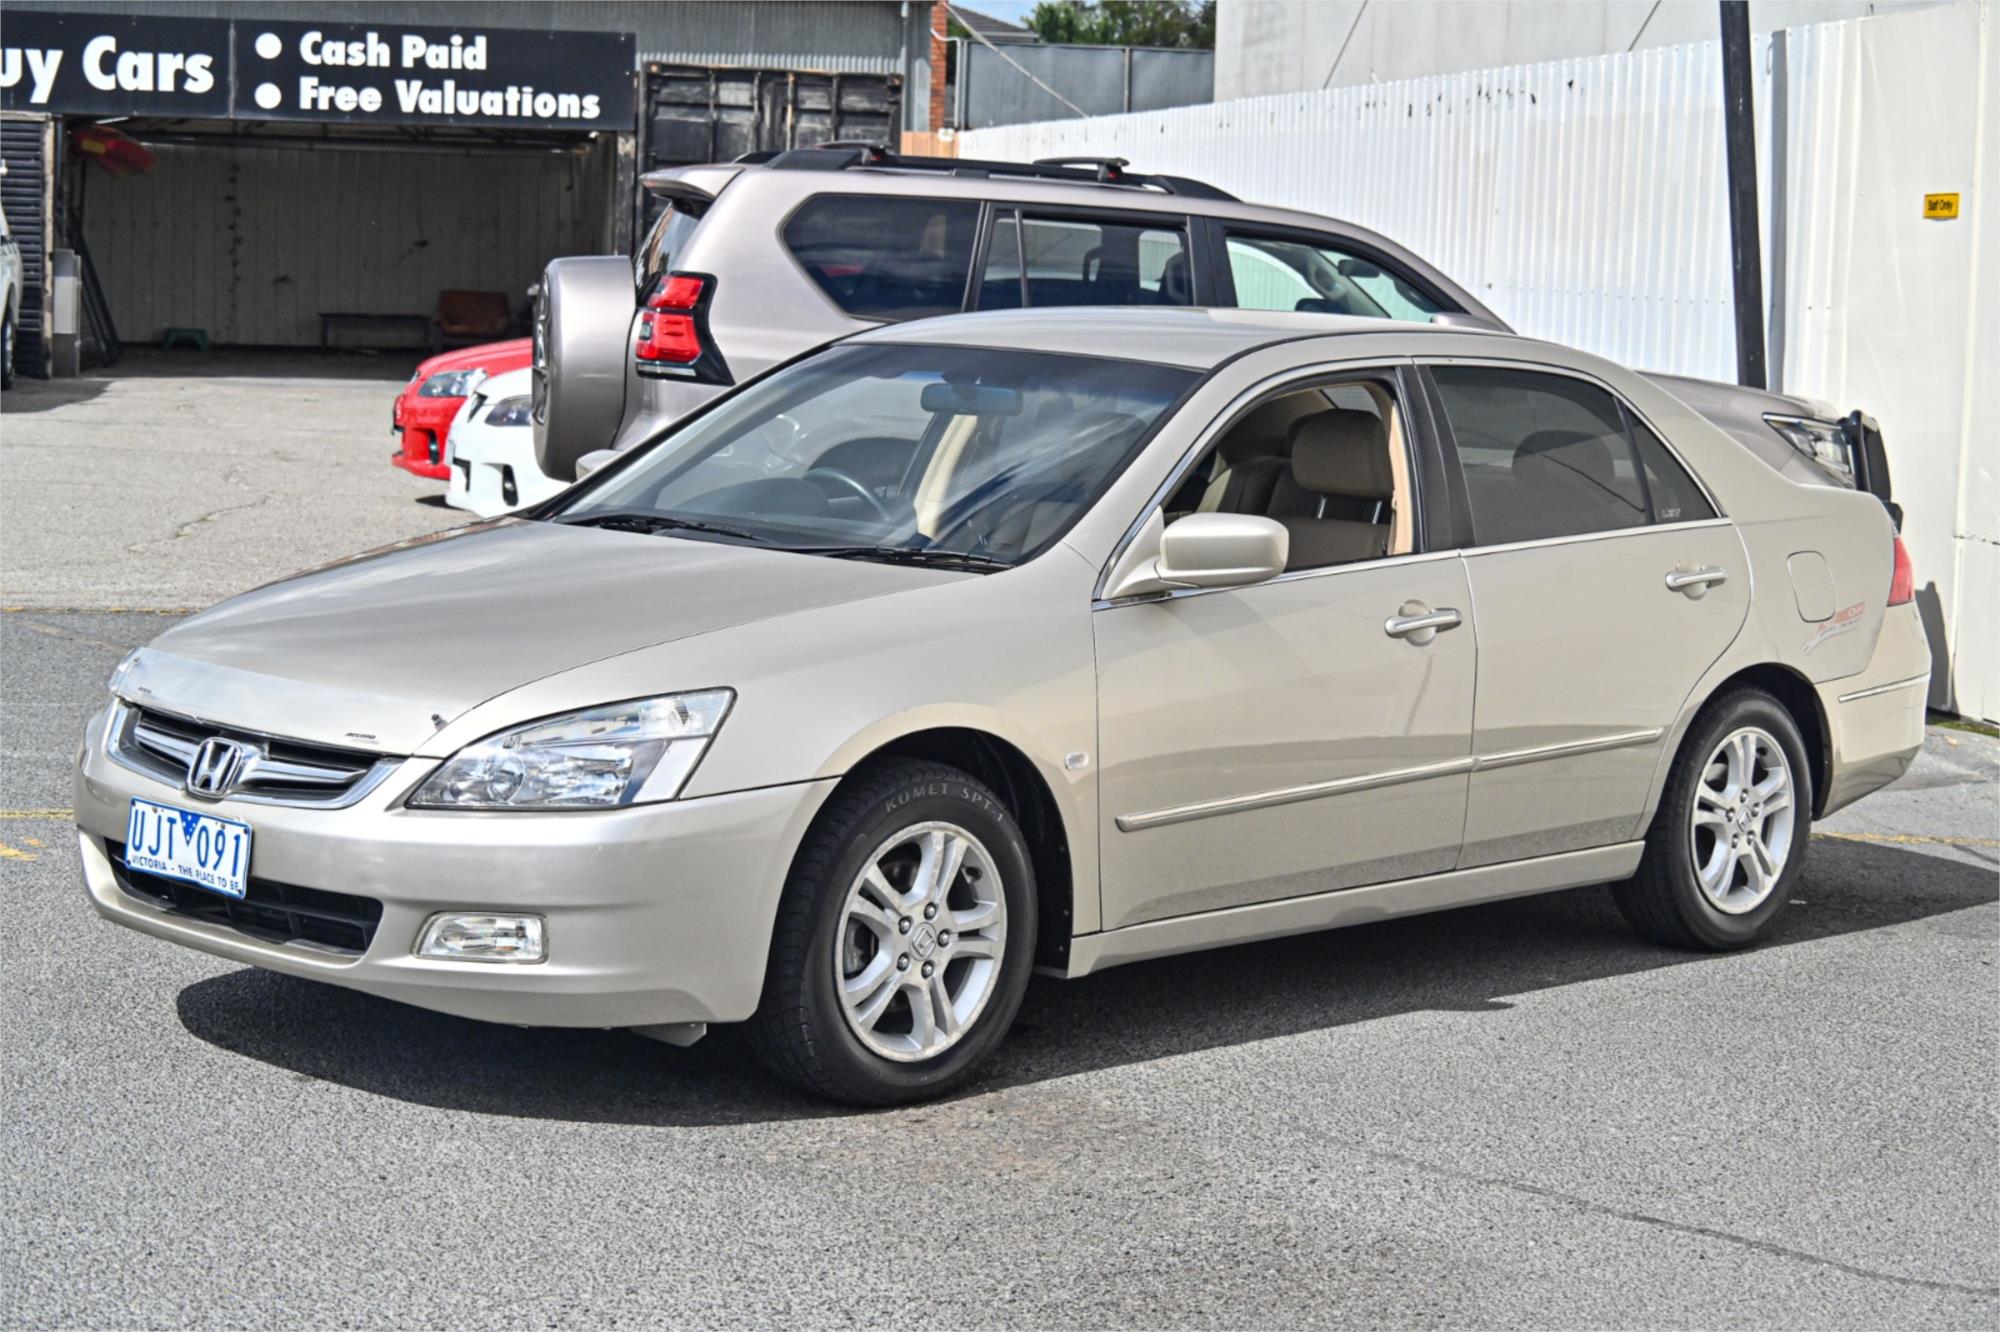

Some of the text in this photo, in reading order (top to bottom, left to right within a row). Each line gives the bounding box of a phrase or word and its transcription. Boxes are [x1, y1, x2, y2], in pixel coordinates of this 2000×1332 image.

[82, 35, 214, 93] Cars
[299, 31, 487, 70] Cash Paid
[299, 76, 601, 119] Free Valuations
[884, 782, 949, 813] KOMET
[132, 809, 241, 877] UJT 091
[132, 854, 167, 871] VICTORIA
[178, 864, 193, 878] THE
[195, 869, 215, 884] PLACE
[217, 876, 227, 888] TO
